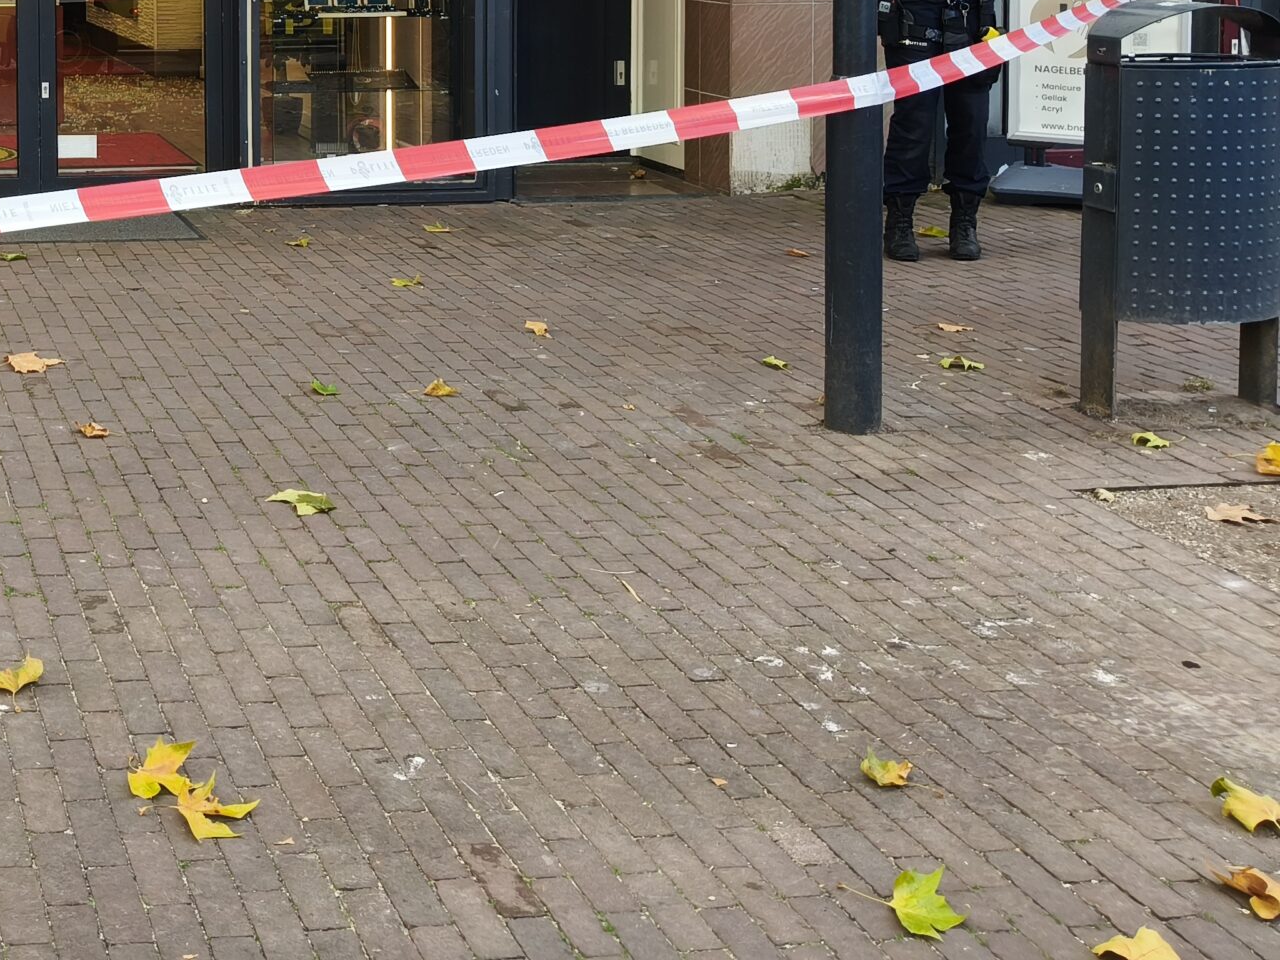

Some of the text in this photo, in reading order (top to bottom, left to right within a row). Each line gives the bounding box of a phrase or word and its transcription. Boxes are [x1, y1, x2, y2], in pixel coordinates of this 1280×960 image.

[1041, 82, 1082, 93] Manicure
[1041, 93, 1067, 103] Gellak
[1041, 104, 1063, 114] Acryl
